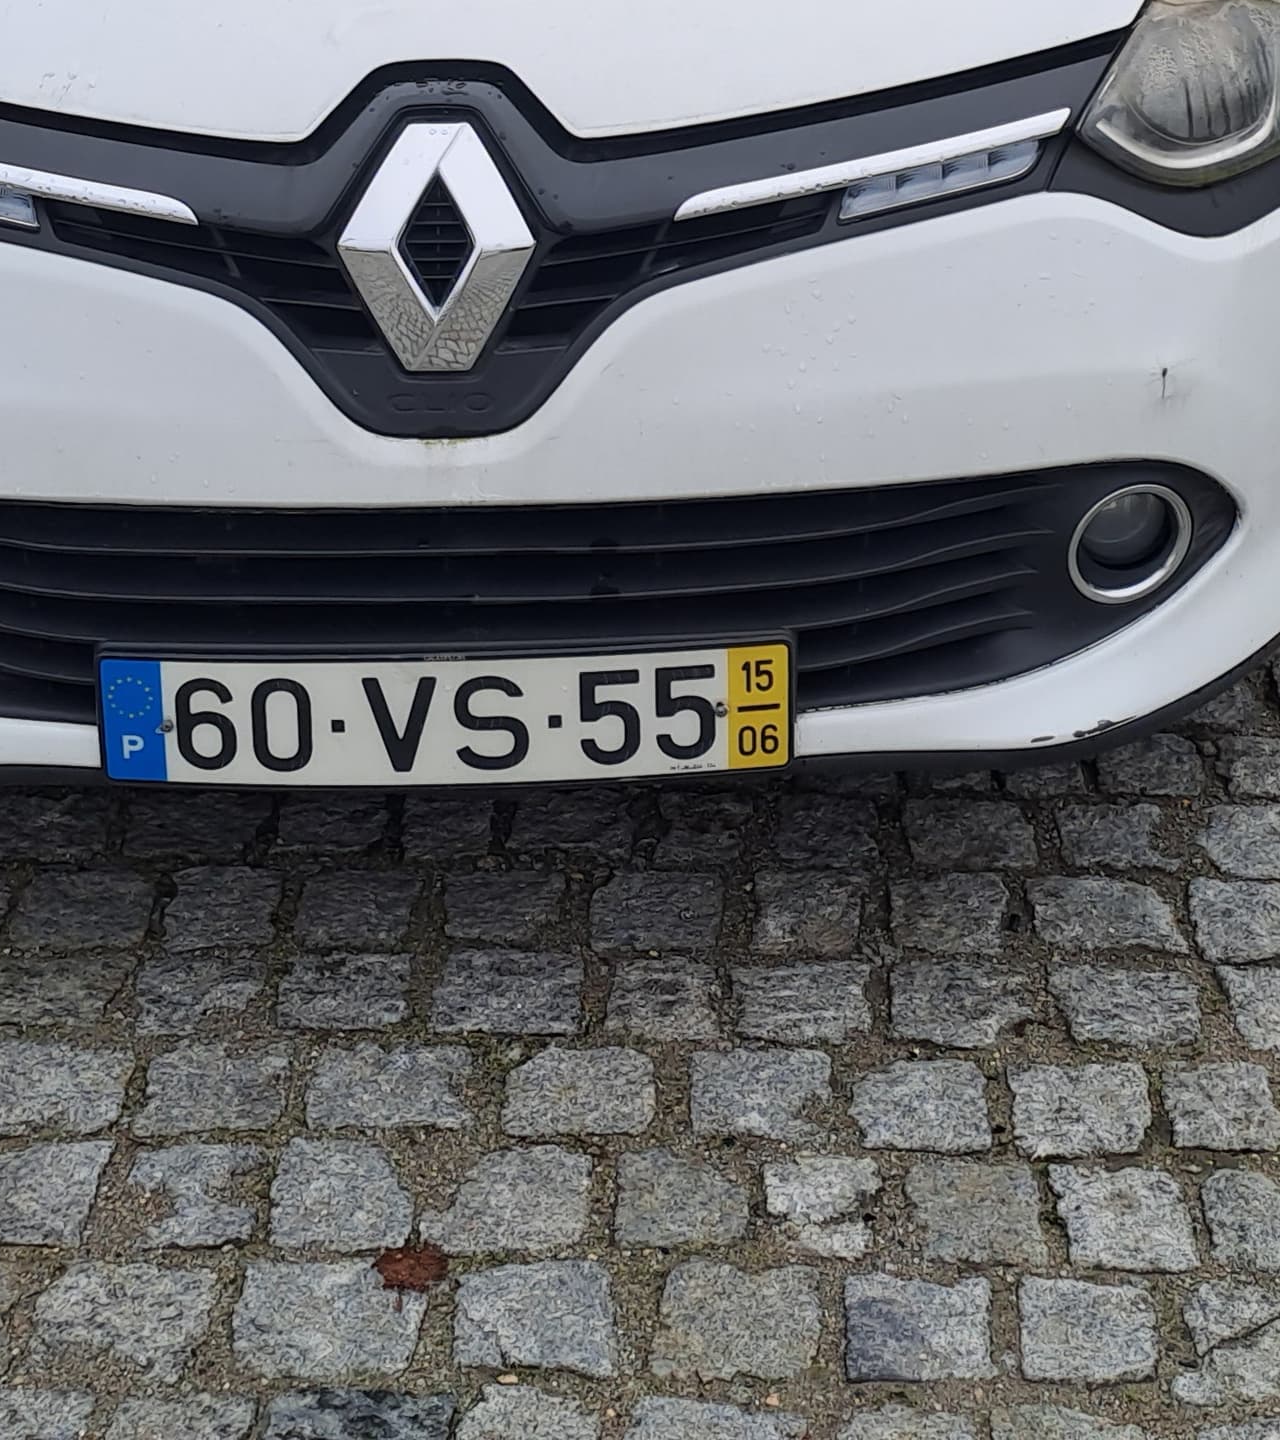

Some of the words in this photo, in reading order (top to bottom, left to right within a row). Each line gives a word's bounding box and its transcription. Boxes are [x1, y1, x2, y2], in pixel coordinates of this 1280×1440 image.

[741, 659, 774, 693] 15
[122, 734, 145, 759] P
[738, 724, 779, 756] 06
